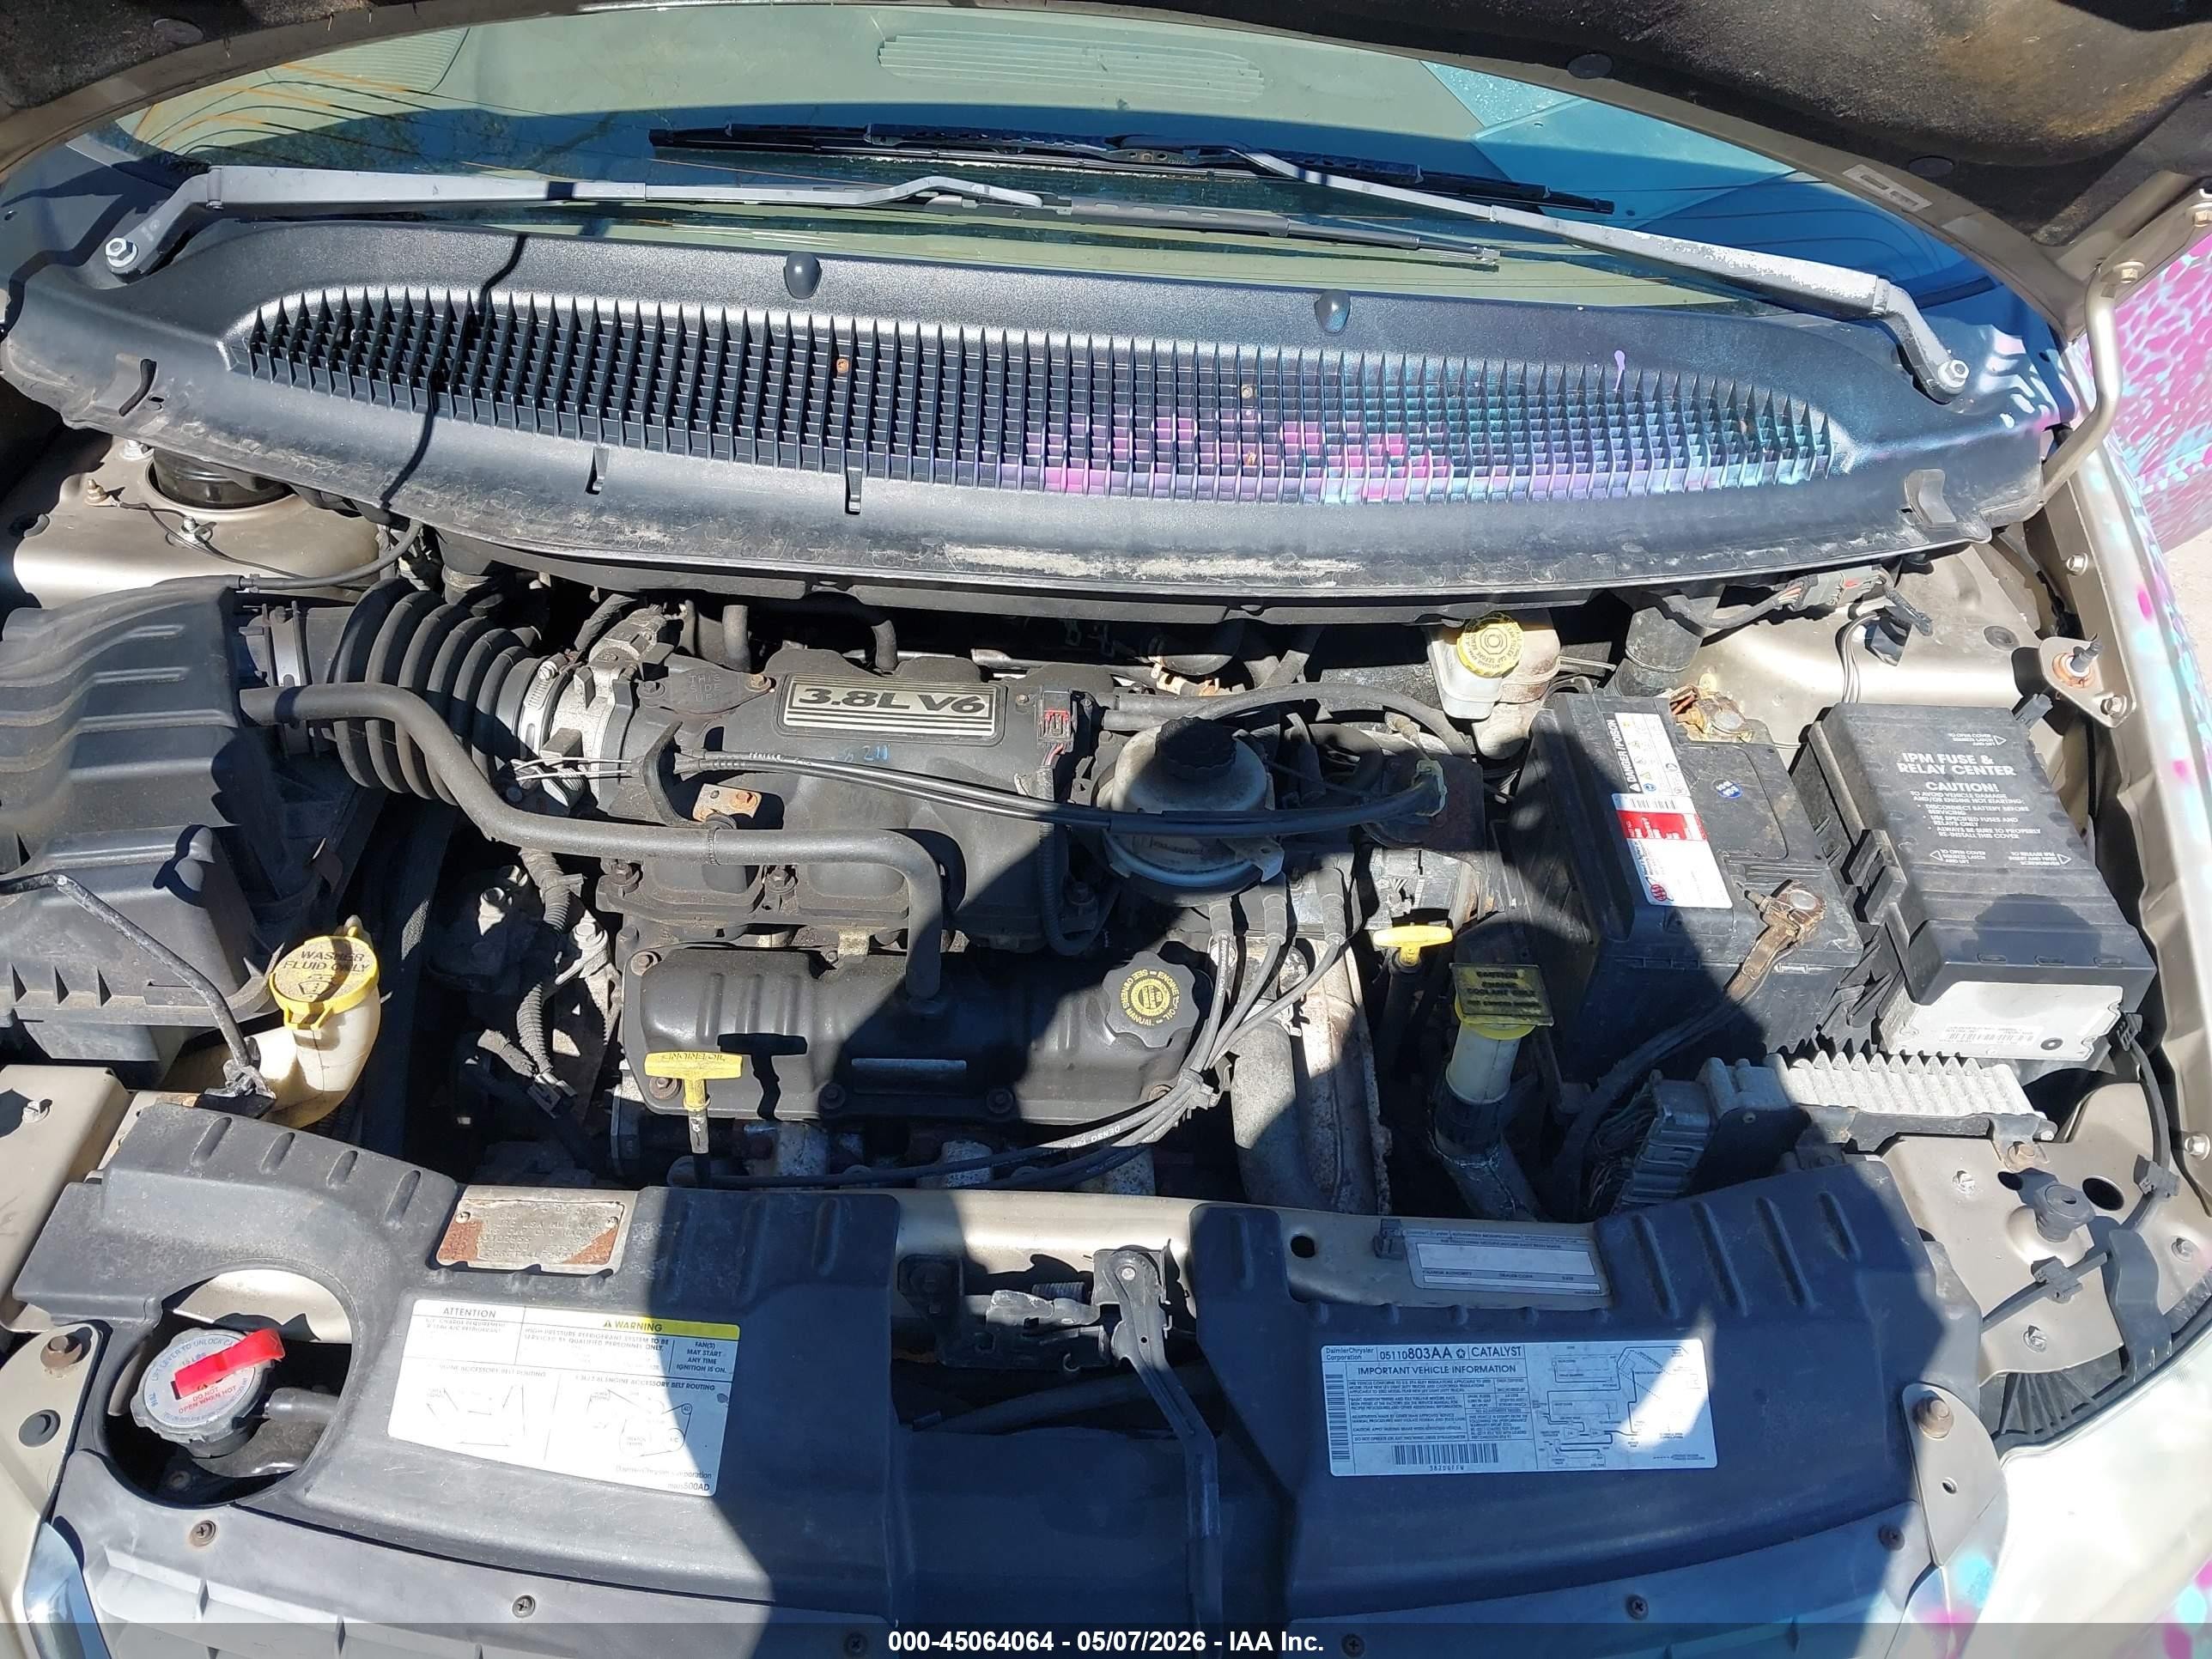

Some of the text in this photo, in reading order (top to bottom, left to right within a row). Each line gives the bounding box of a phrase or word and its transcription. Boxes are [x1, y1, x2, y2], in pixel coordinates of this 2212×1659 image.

[688, 672, 721, 684] THIS
[690, 683, 722, 693] SIDE
[696, 693, 713, 702] UP
[799, 688, 987, 714] 3.8L V6
[1902, 752, 1995, 765] IPM FUSE &
[1896, 763, 2018, 776] RELAY CENTER
[1925, 781, 2000, 793] CAUTION!
[300, 951, 365, 962] WASHER
[283, 960, 370, 973] FLUID ONLY
[1132, 969, 1148, 981] SEE
[1120, 977, 1134, 1009] OWNERS
[1157, 970, 1180, 1024] ENGINE OIL
[1091, 1125, 1121, 1143] DENSO
[443, 1307, 496, 1319] ATTENTION
[615, 1321, 663, 1333] WARNING
[181, 1343, 192, 1352] TO
[193, 1337, 224, 1348] UNLOCK
[695, 1341, 716, 1350] FAN(S)
[1325, 1346, 1522, 1360] DaimlerChrysler 05110803AA CATALYST
[1325, 1353, 1362, 1362] Corporation
[676, 1364, 707, 1372] IGNITION
[714, 1365, 727, 1374] ON.
[1358, 1364, 1516, 1376] IMPORTANT VEHICLE INFORMATION
[630, 1379, 670, 1389] ACCESSORY
[685, 1382, 716, 1391] ROUTING
[178, 1384, 238, 1414] OPEN WHEN HOT
[191, 1386, 219, 1402] DO NOT
